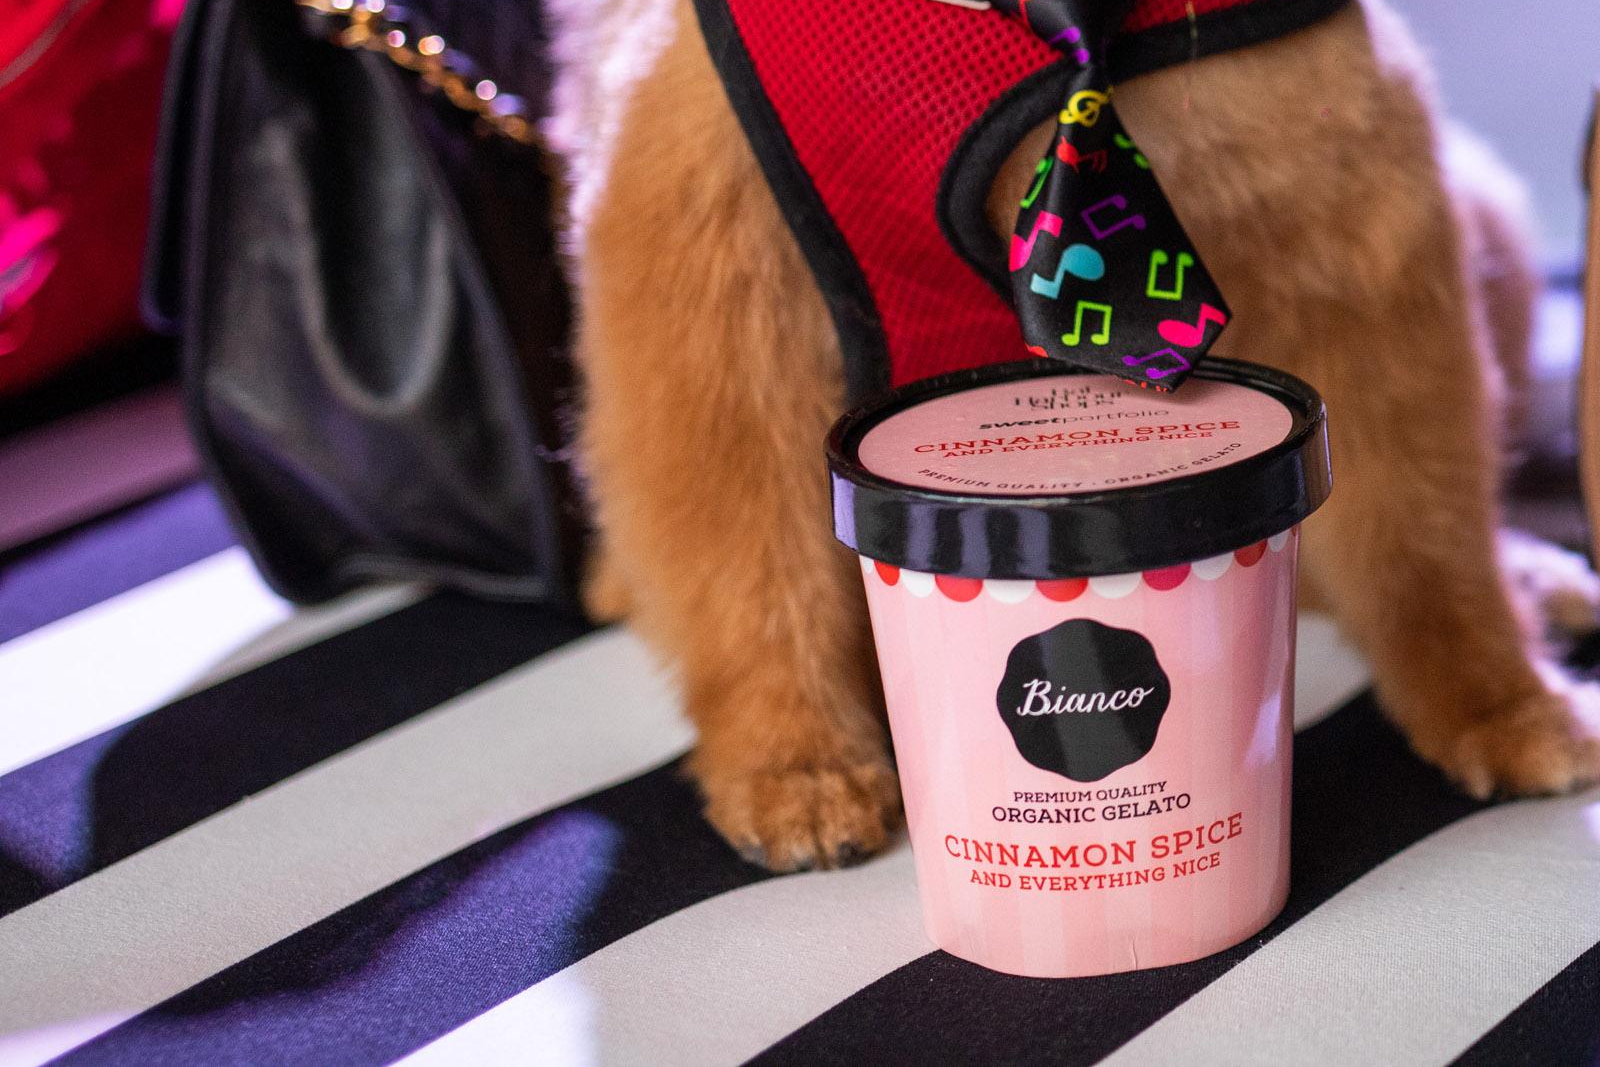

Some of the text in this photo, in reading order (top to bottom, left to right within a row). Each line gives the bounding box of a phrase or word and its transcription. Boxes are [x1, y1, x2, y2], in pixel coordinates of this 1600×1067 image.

[979, 410, 1170, 430] sweetportfolio
[914, 421, 1240, 453] CINNAMON SPICE
[943, 431, 1213, 458] AND EVERYTHING NICE
[918, 442, 1241, 490] PREMIUM QUALITY ORGANIC GELATO
[1016, 679, 1155, 717] Bianco
[1013, 780, 1167, 803] PREMIUM QUALITY
[992, 792, 1191, 824] ORGANIC GELATO
[944, 811, 1244, 869] CINNAMON SPICE
[969, 851, 1221, 891] AND EVERYTHING NICE
